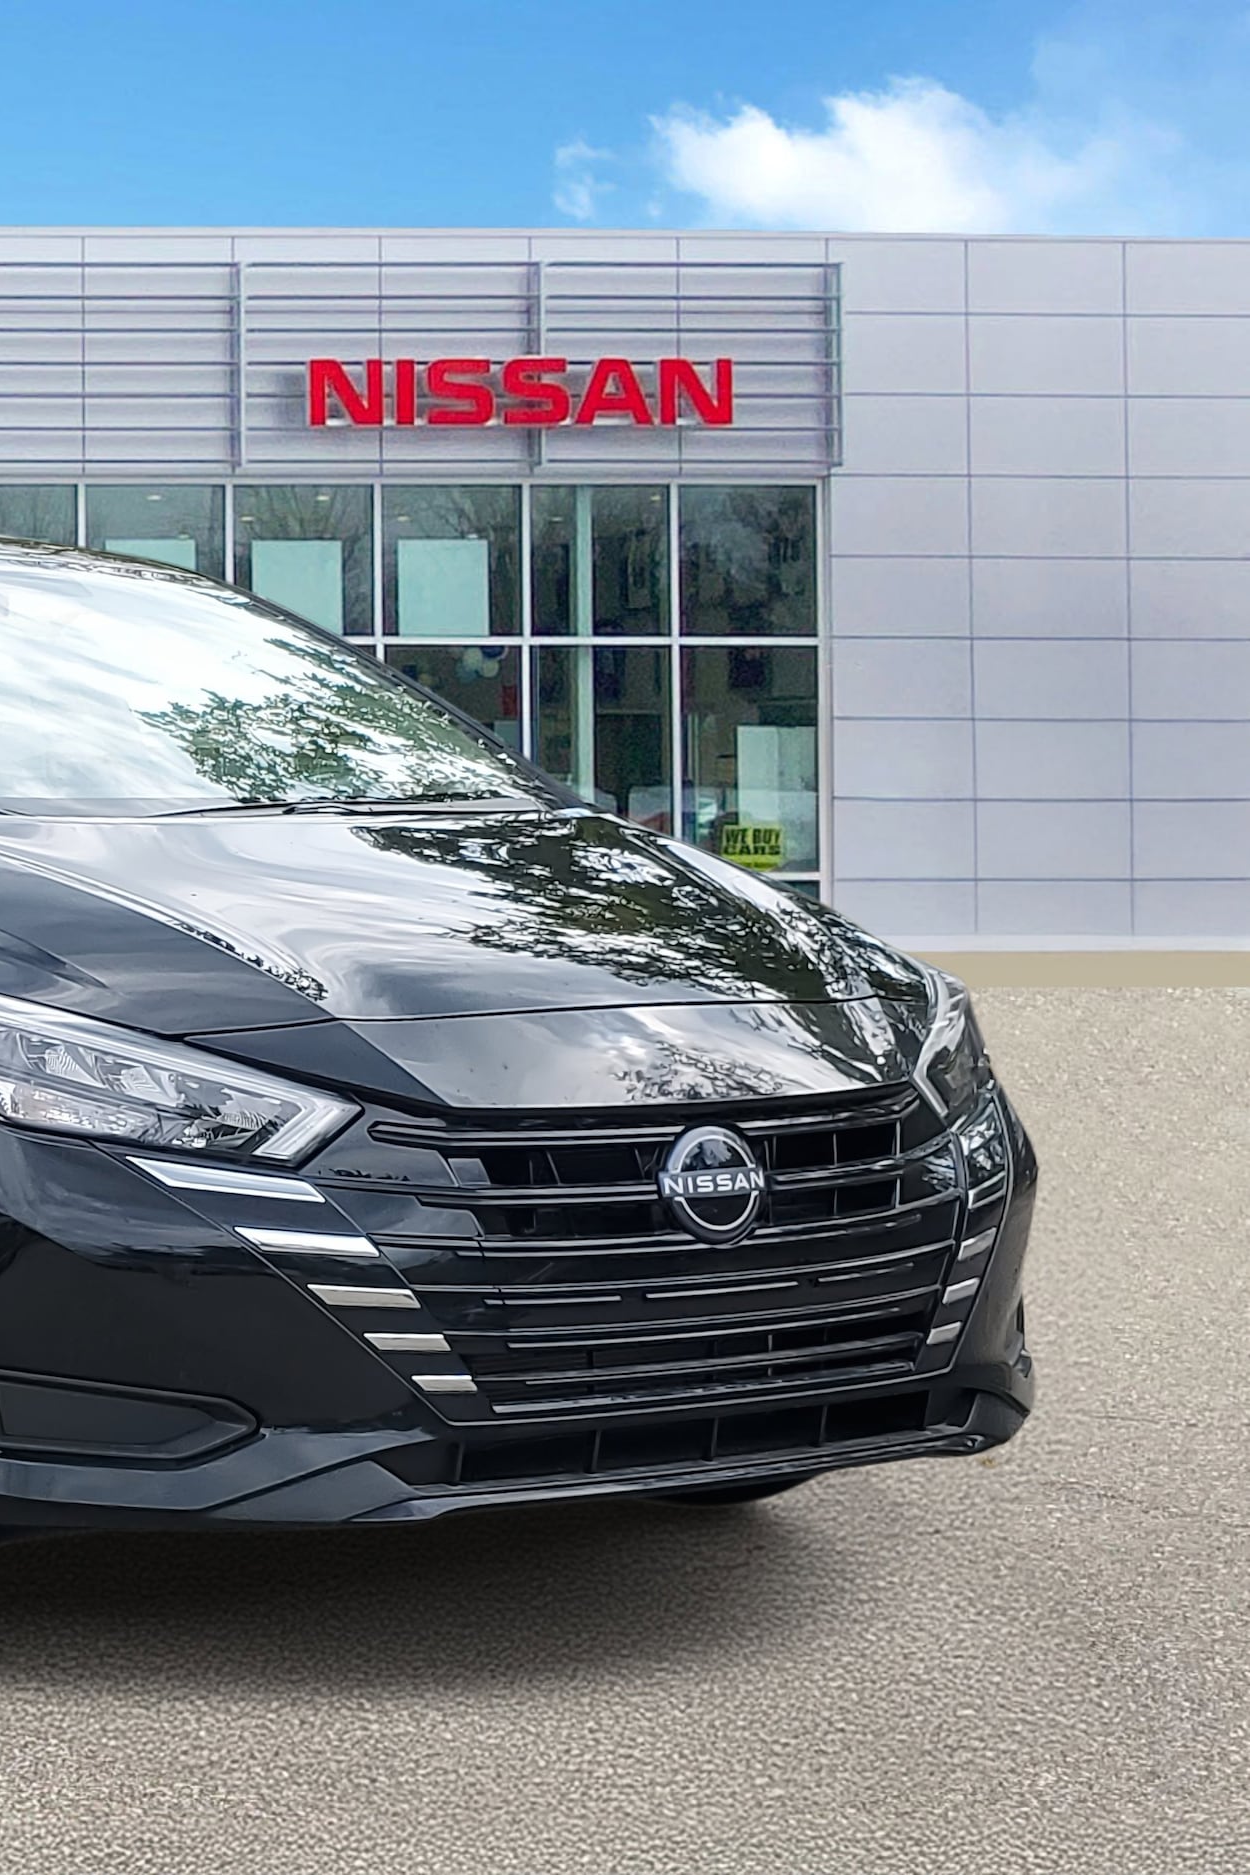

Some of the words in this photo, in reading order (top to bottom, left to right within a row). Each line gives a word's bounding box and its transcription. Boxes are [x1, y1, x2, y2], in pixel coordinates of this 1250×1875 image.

[309, 357, 733, 426] NISSAN
[724, 828, 748, 844] WE
[752, 828, 781, 844] BUY
[723, 844, 781, 856] CARS
[663, 1169, 765, 1194] NISSAN
